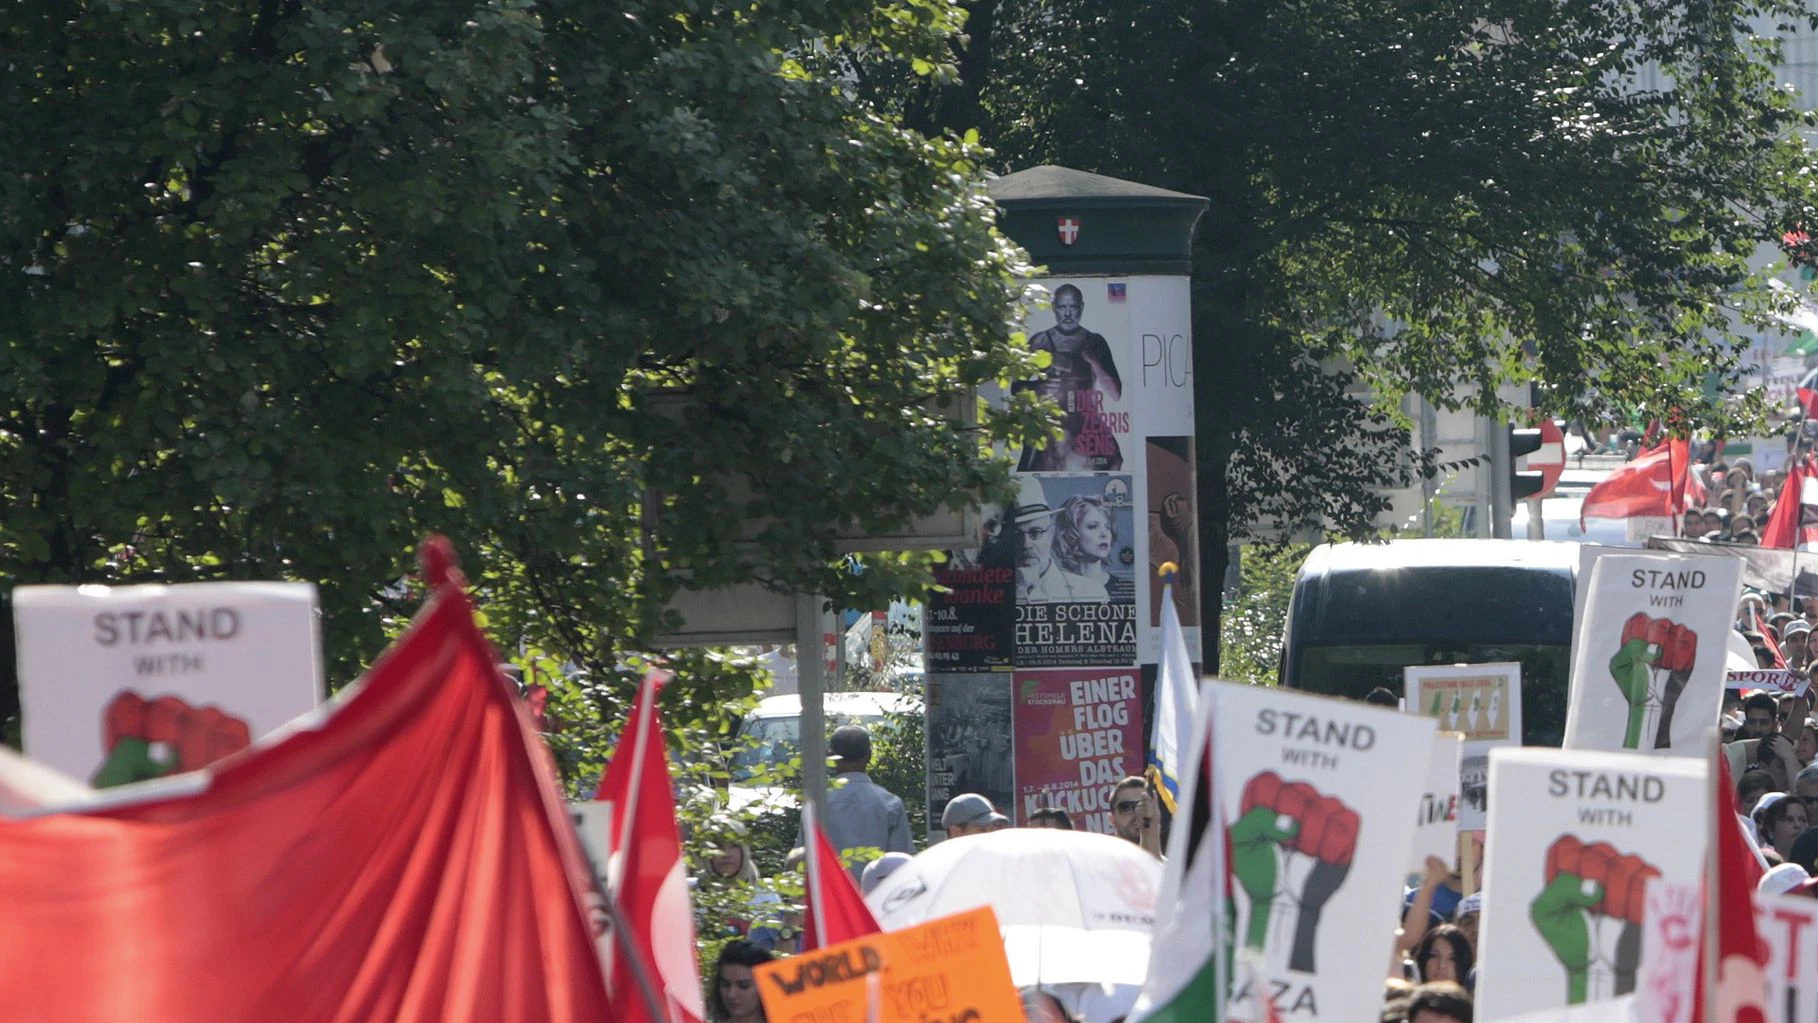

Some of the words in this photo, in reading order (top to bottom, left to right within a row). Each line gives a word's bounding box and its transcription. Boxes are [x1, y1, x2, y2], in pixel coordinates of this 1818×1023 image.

[1631, 569, 1706, 590] STAND
[1015, 605, 1047, 622] DIE
[1055, 600, 1137, 620] SCHÖNE
[1649, 594, 1684, 608] WITH
[94, 606, 240, 647] STAND
[1015, 621, 1137, 645] HELENA
[133, 653, 205, 676] WITH
[1070, 675, 1136, 706] EINER
[1073, 701, 1129, 731] FLOG
[1255, 708, 1376, 751] STAND
[1059, 729, 1125, 761] ÜBER
[1281, 745, 1340, 772] WITH
[1079, 756, 1127, 788] DAS
[1549, 768, 1665, 804] STAND
[1024, 785, 1112, 819] KUCKUC
[1577, 806, 1632, 827] WITH
[768, 945, 882, 997] WORLD
[1233, 978, 1318, 1017] AZA
